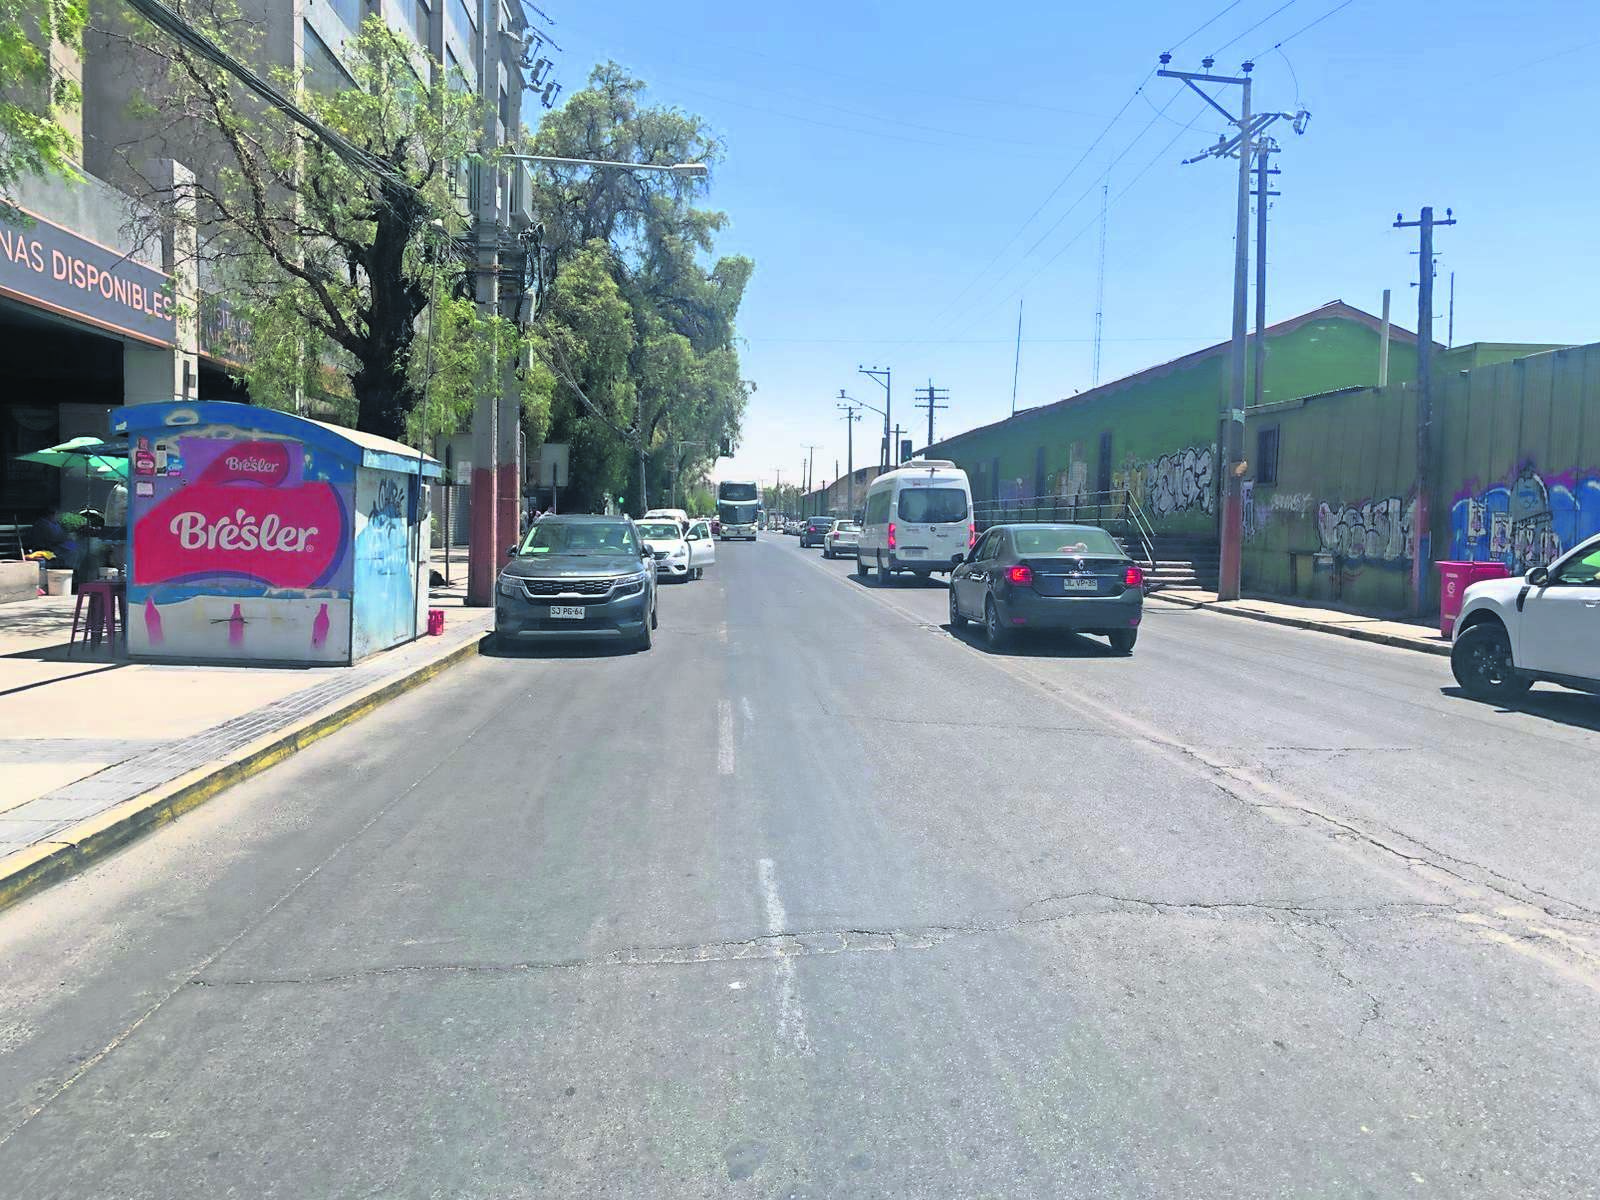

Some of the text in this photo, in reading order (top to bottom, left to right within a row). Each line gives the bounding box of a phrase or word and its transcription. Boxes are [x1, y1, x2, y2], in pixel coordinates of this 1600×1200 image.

[52, 249, 173, 321] DISPONIBLES
[225, 456, 279, 473] Bresler
[169, 508, 319, 552] Bresler
